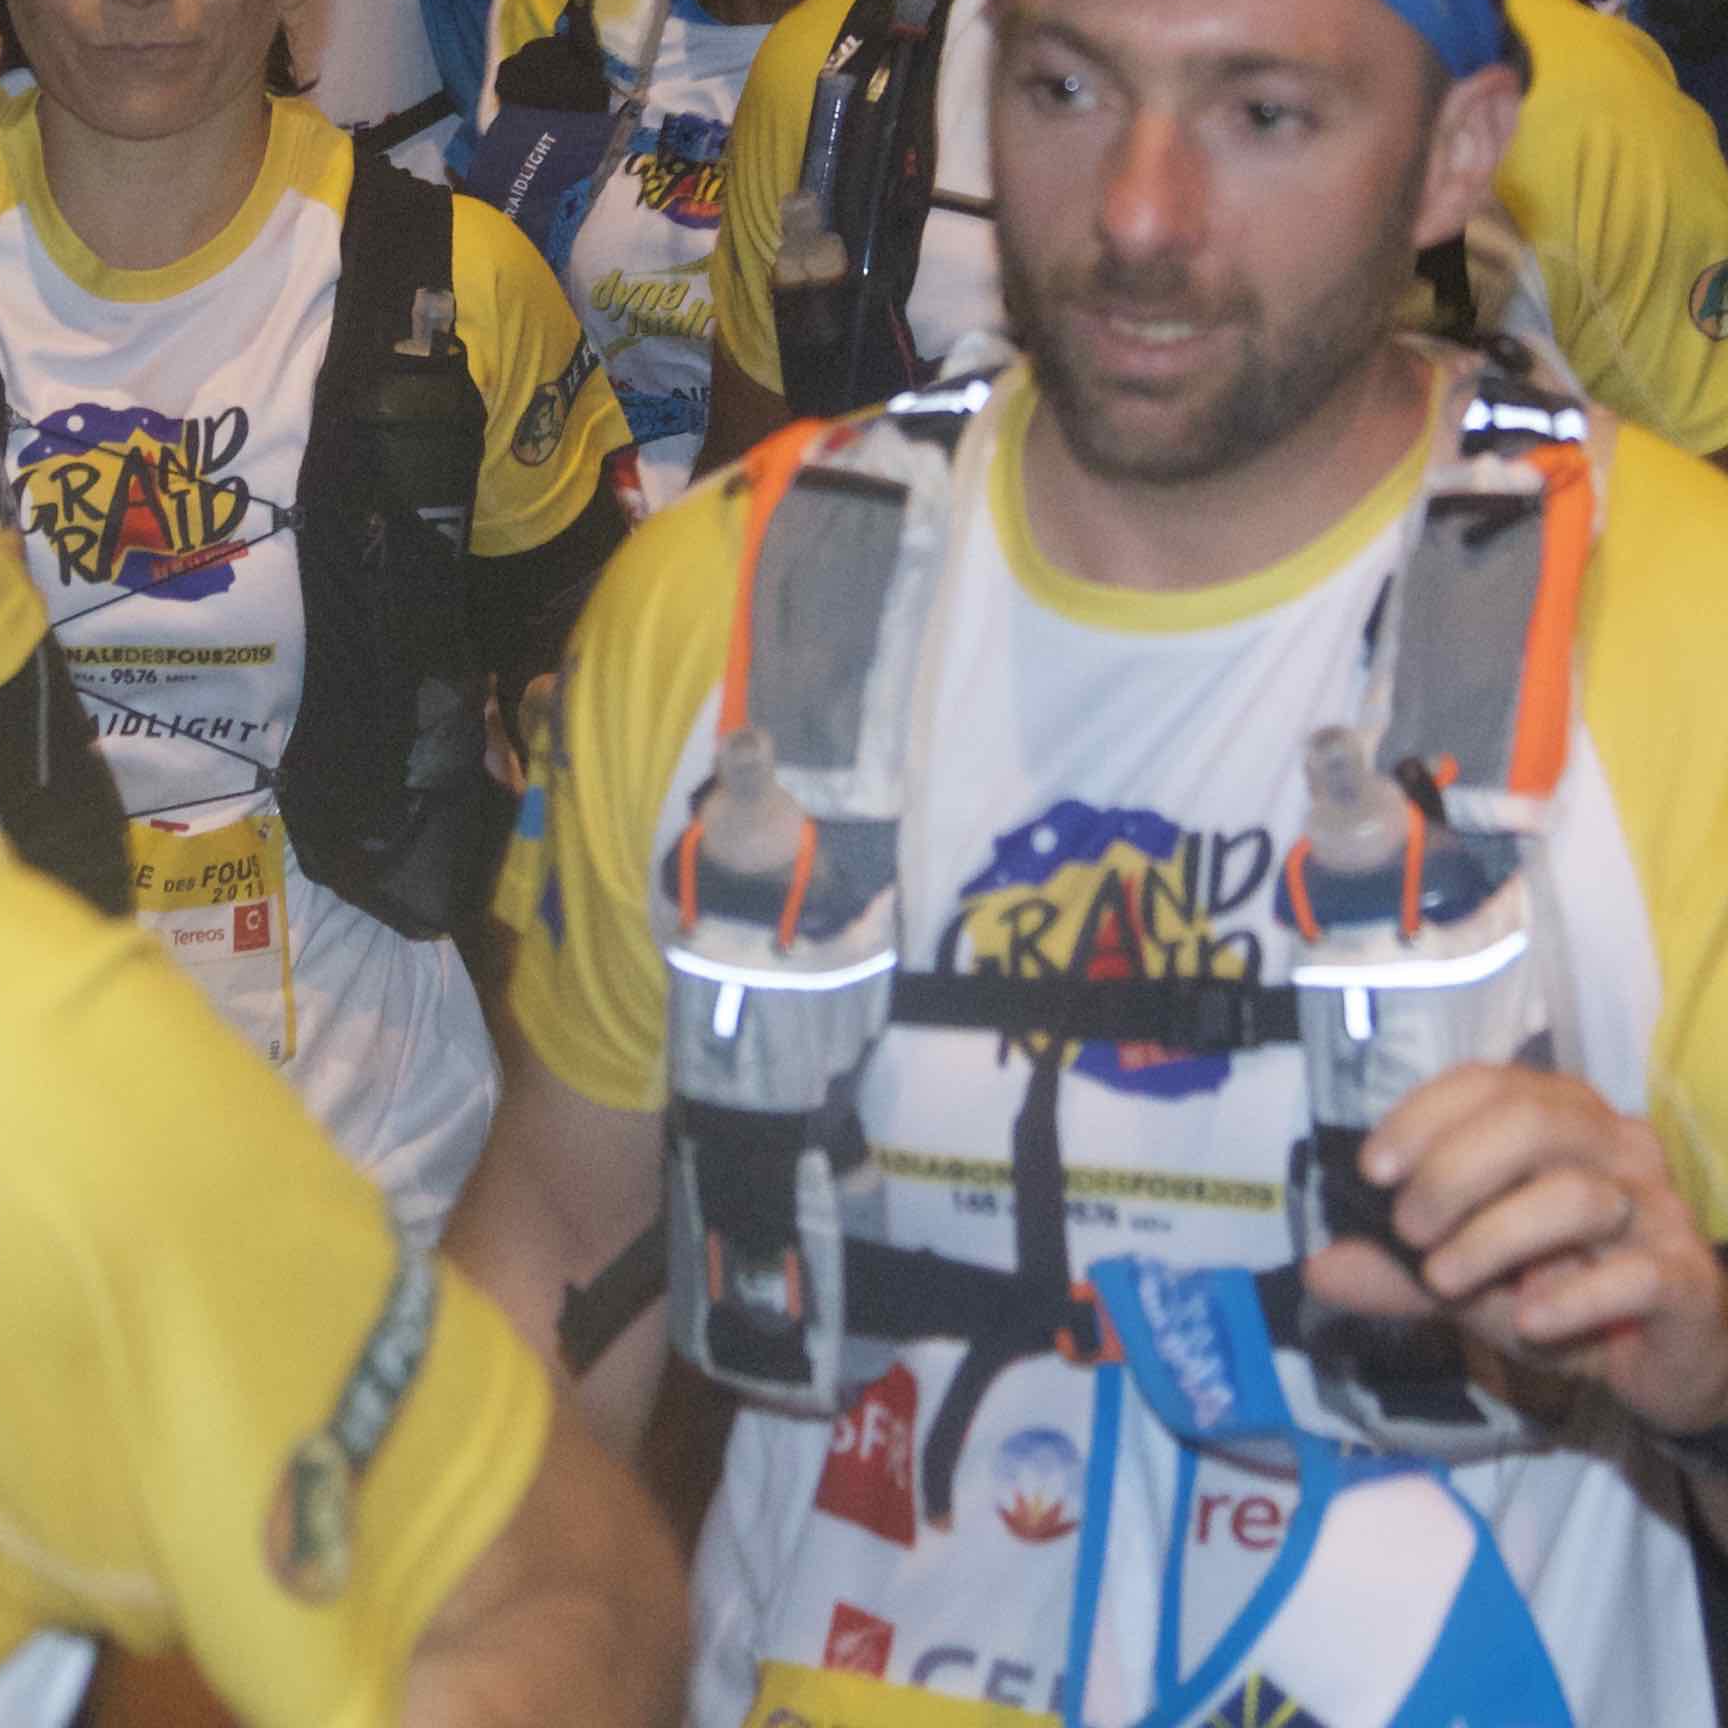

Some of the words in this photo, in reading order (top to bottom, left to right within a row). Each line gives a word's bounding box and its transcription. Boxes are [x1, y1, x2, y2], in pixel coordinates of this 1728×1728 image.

[503, 130, 558, 220] RAIDLIGHT
[10, 406, 250, 536] GRAND
[111, 669, 158, 685] 9576
[172, 928, 225, 946] Tereos
